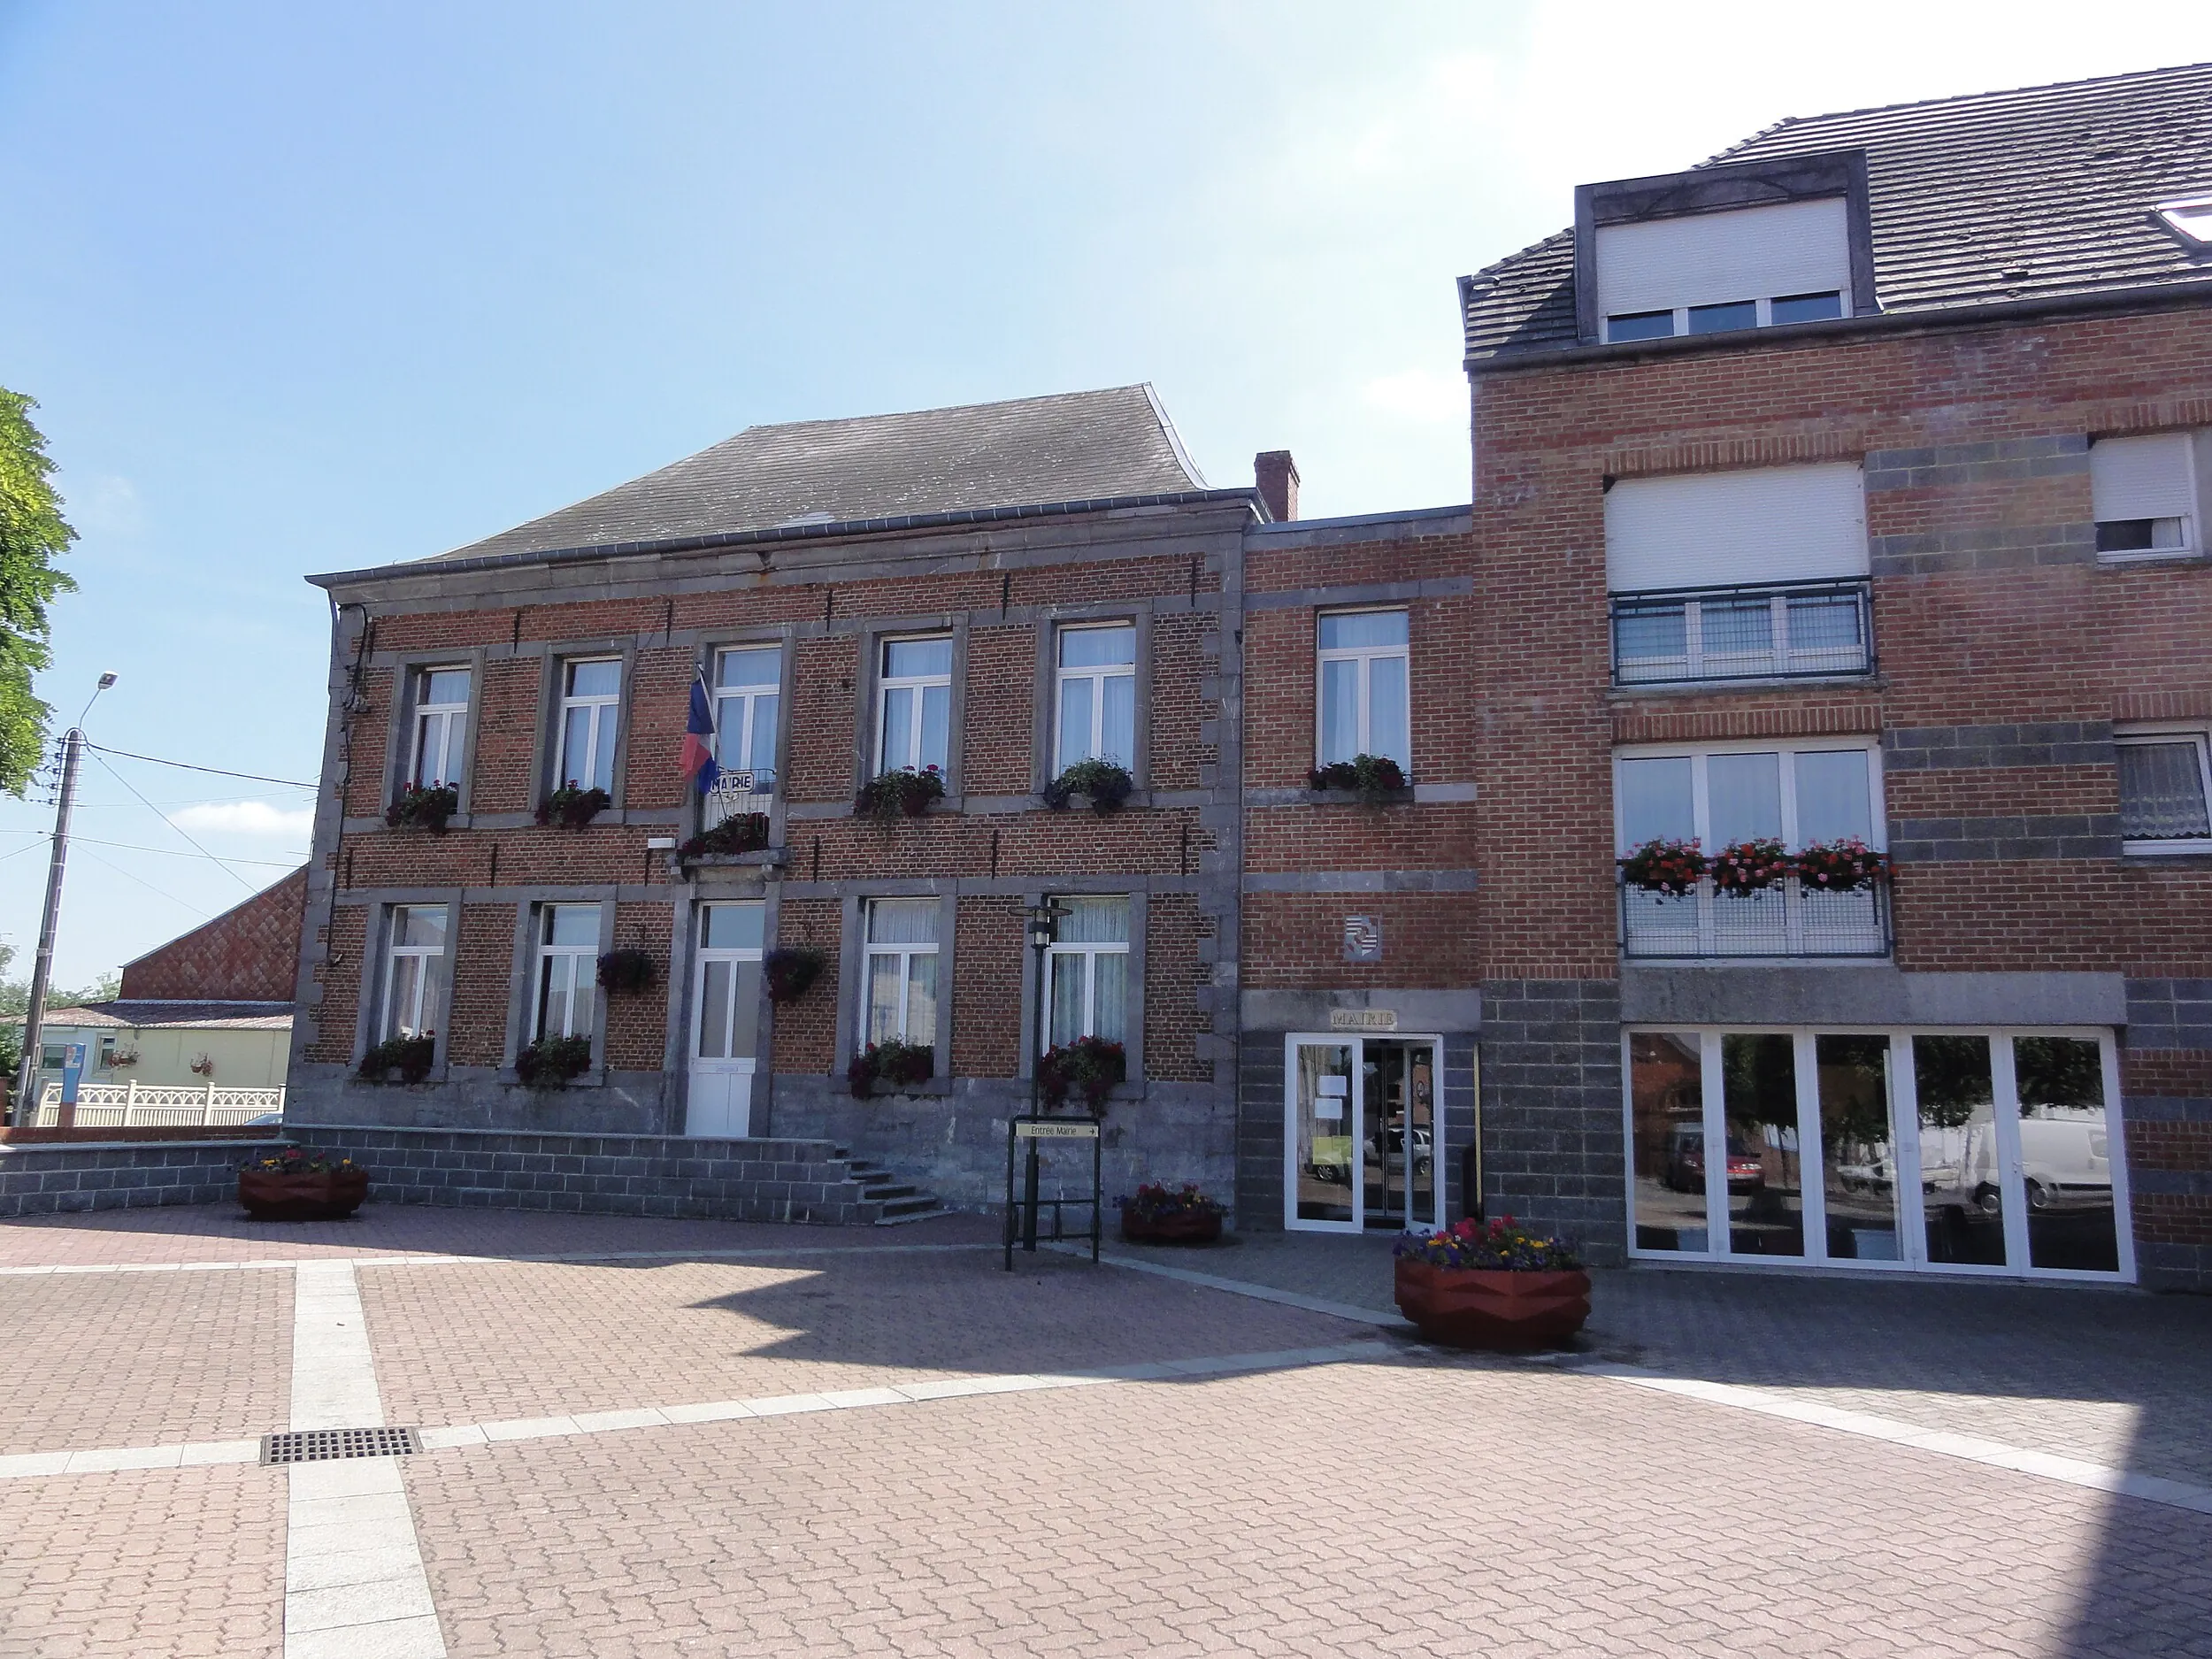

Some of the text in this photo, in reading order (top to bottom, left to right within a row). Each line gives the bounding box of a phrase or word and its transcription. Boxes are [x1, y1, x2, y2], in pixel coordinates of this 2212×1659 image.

[1333, 1012, 1394, 1025] MAIRIE
[1031, 1125, 1077, 1136] Entrée Mairie
